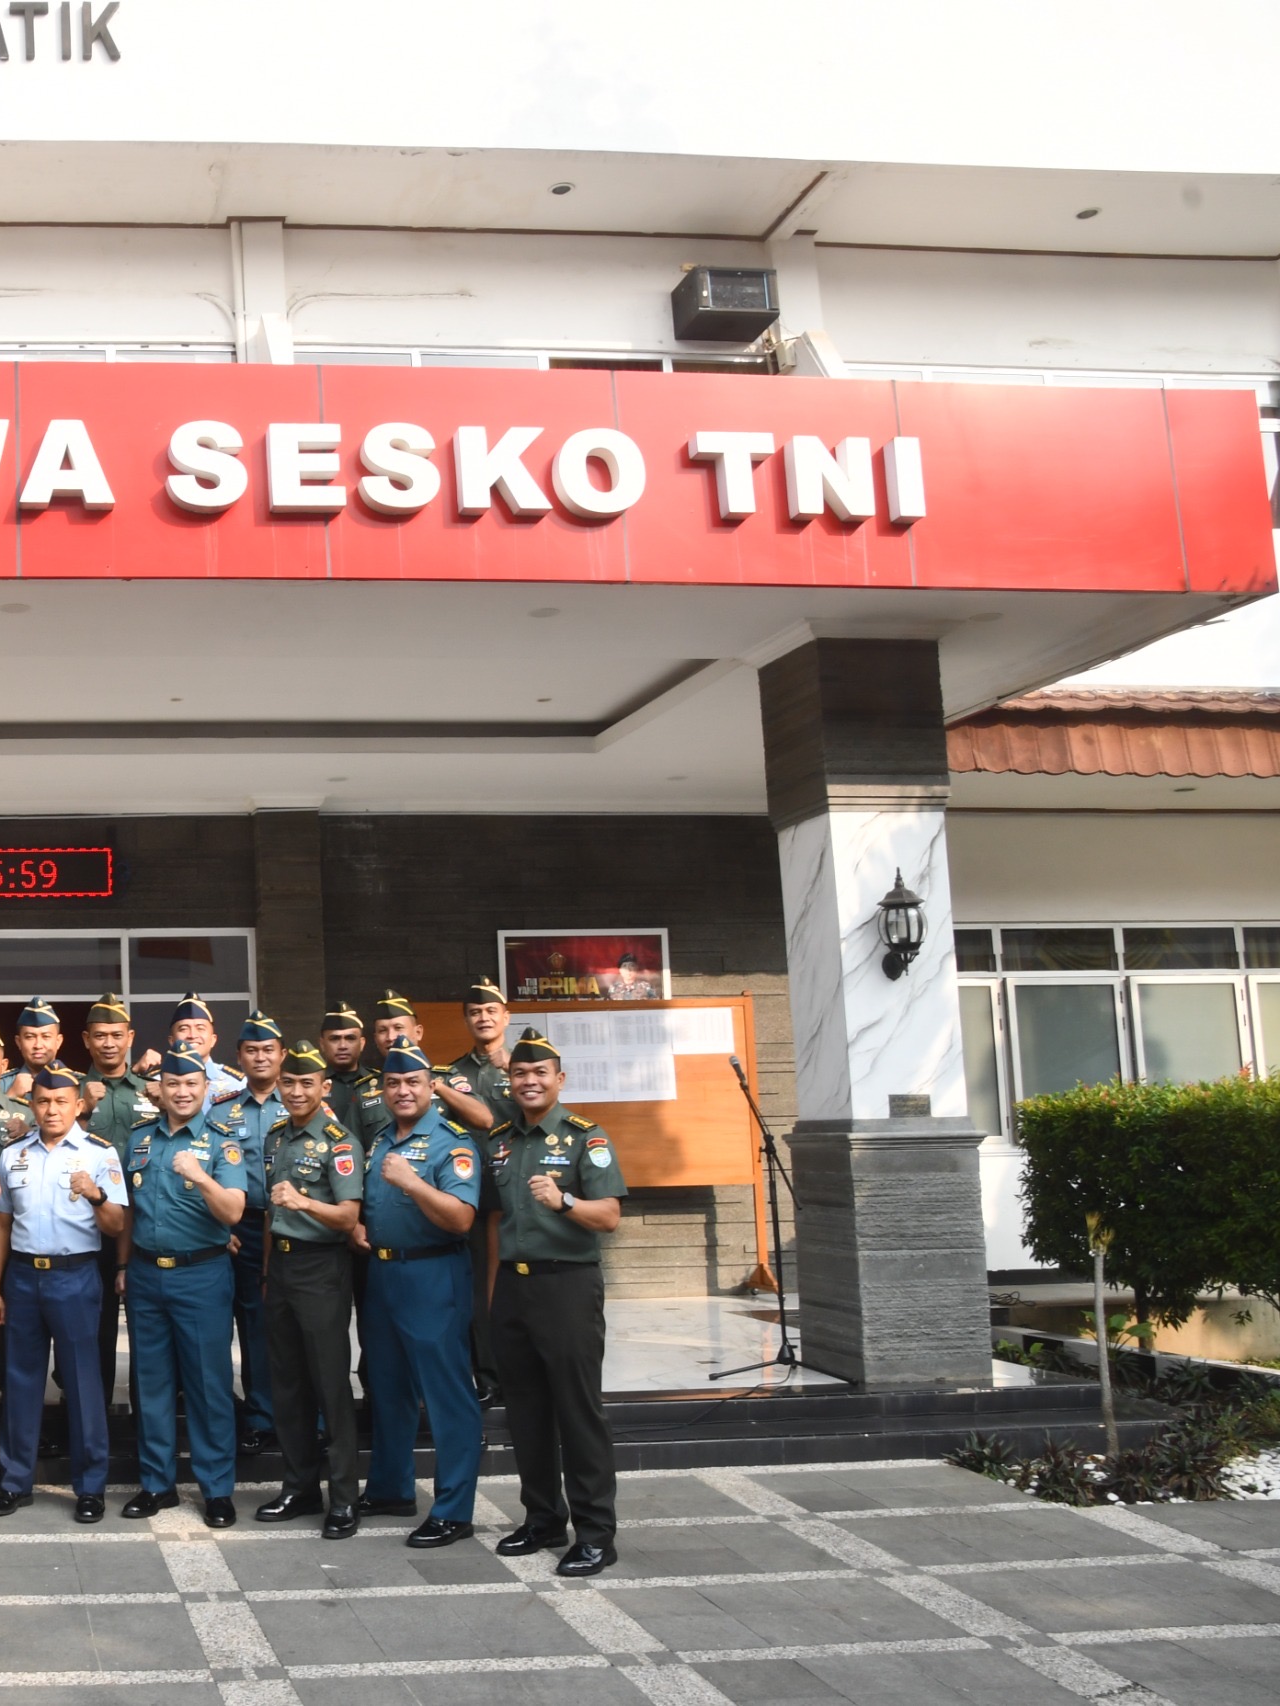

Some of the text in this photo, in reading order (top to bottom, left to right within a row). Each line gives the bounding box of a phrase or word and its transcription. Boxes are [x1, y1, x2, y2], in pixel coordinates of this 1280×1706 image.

[166, 419, 646, 519] SESKO
[688, 430, 927, 525] TNI
[538, 976, 600, 995] PRIMA
